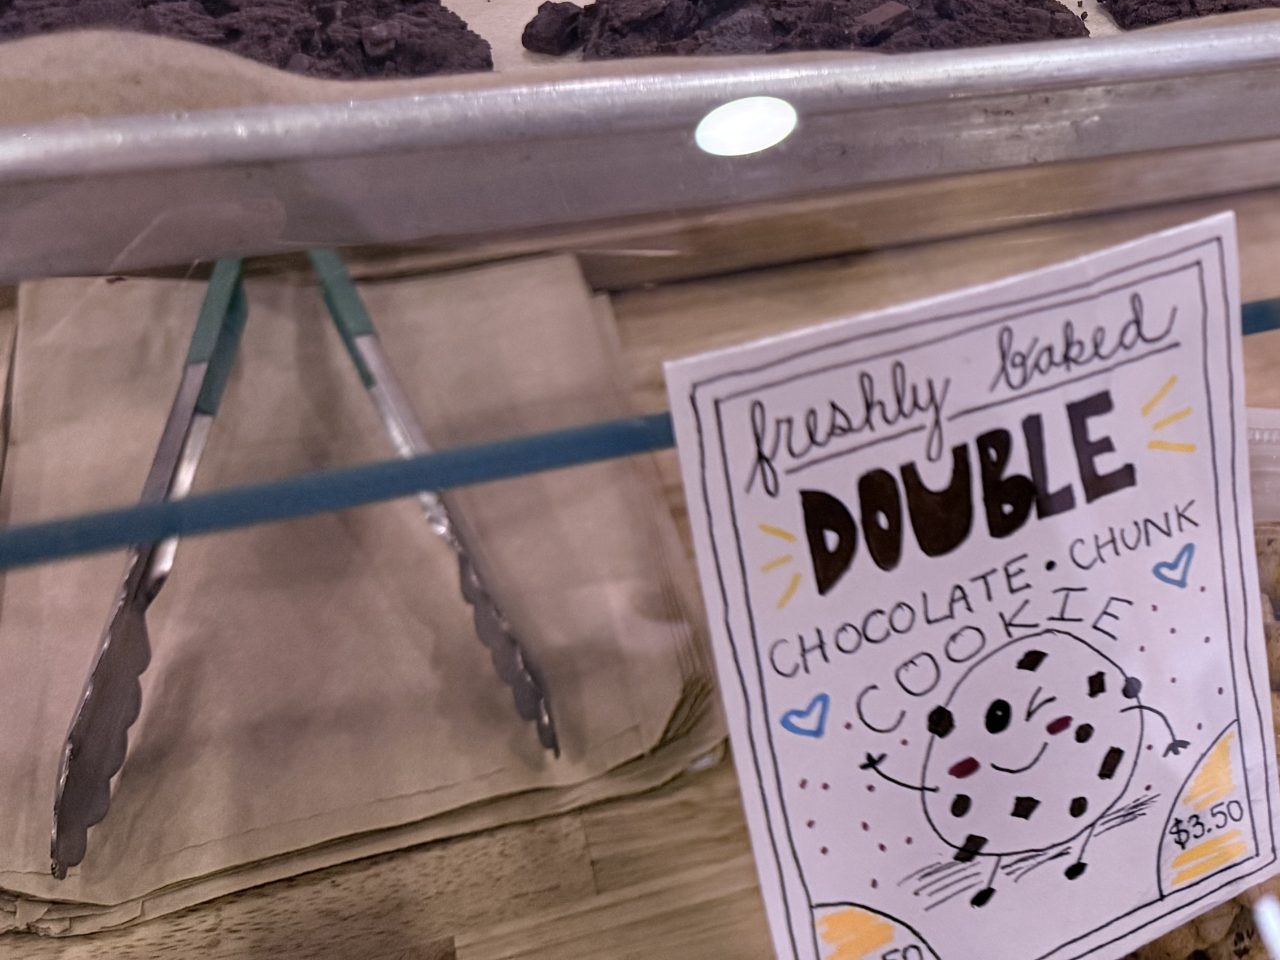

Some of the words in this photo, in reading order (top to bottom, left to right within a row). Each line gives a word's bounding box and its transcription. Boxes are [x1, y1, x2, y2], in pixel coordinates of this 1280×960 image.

[745, 361, 951, 498] freshly
[989, 292, 1178, 393] baked
[799, 389, 1136, 596] DOUBLE
[769, 553, 1032, 678] CHOCOLATE
[1070, 499, 1201, 568] CHUNK
[856, 587, 1134, 733] COOKIE
[1169, 799, 1244, 850] $3.50
